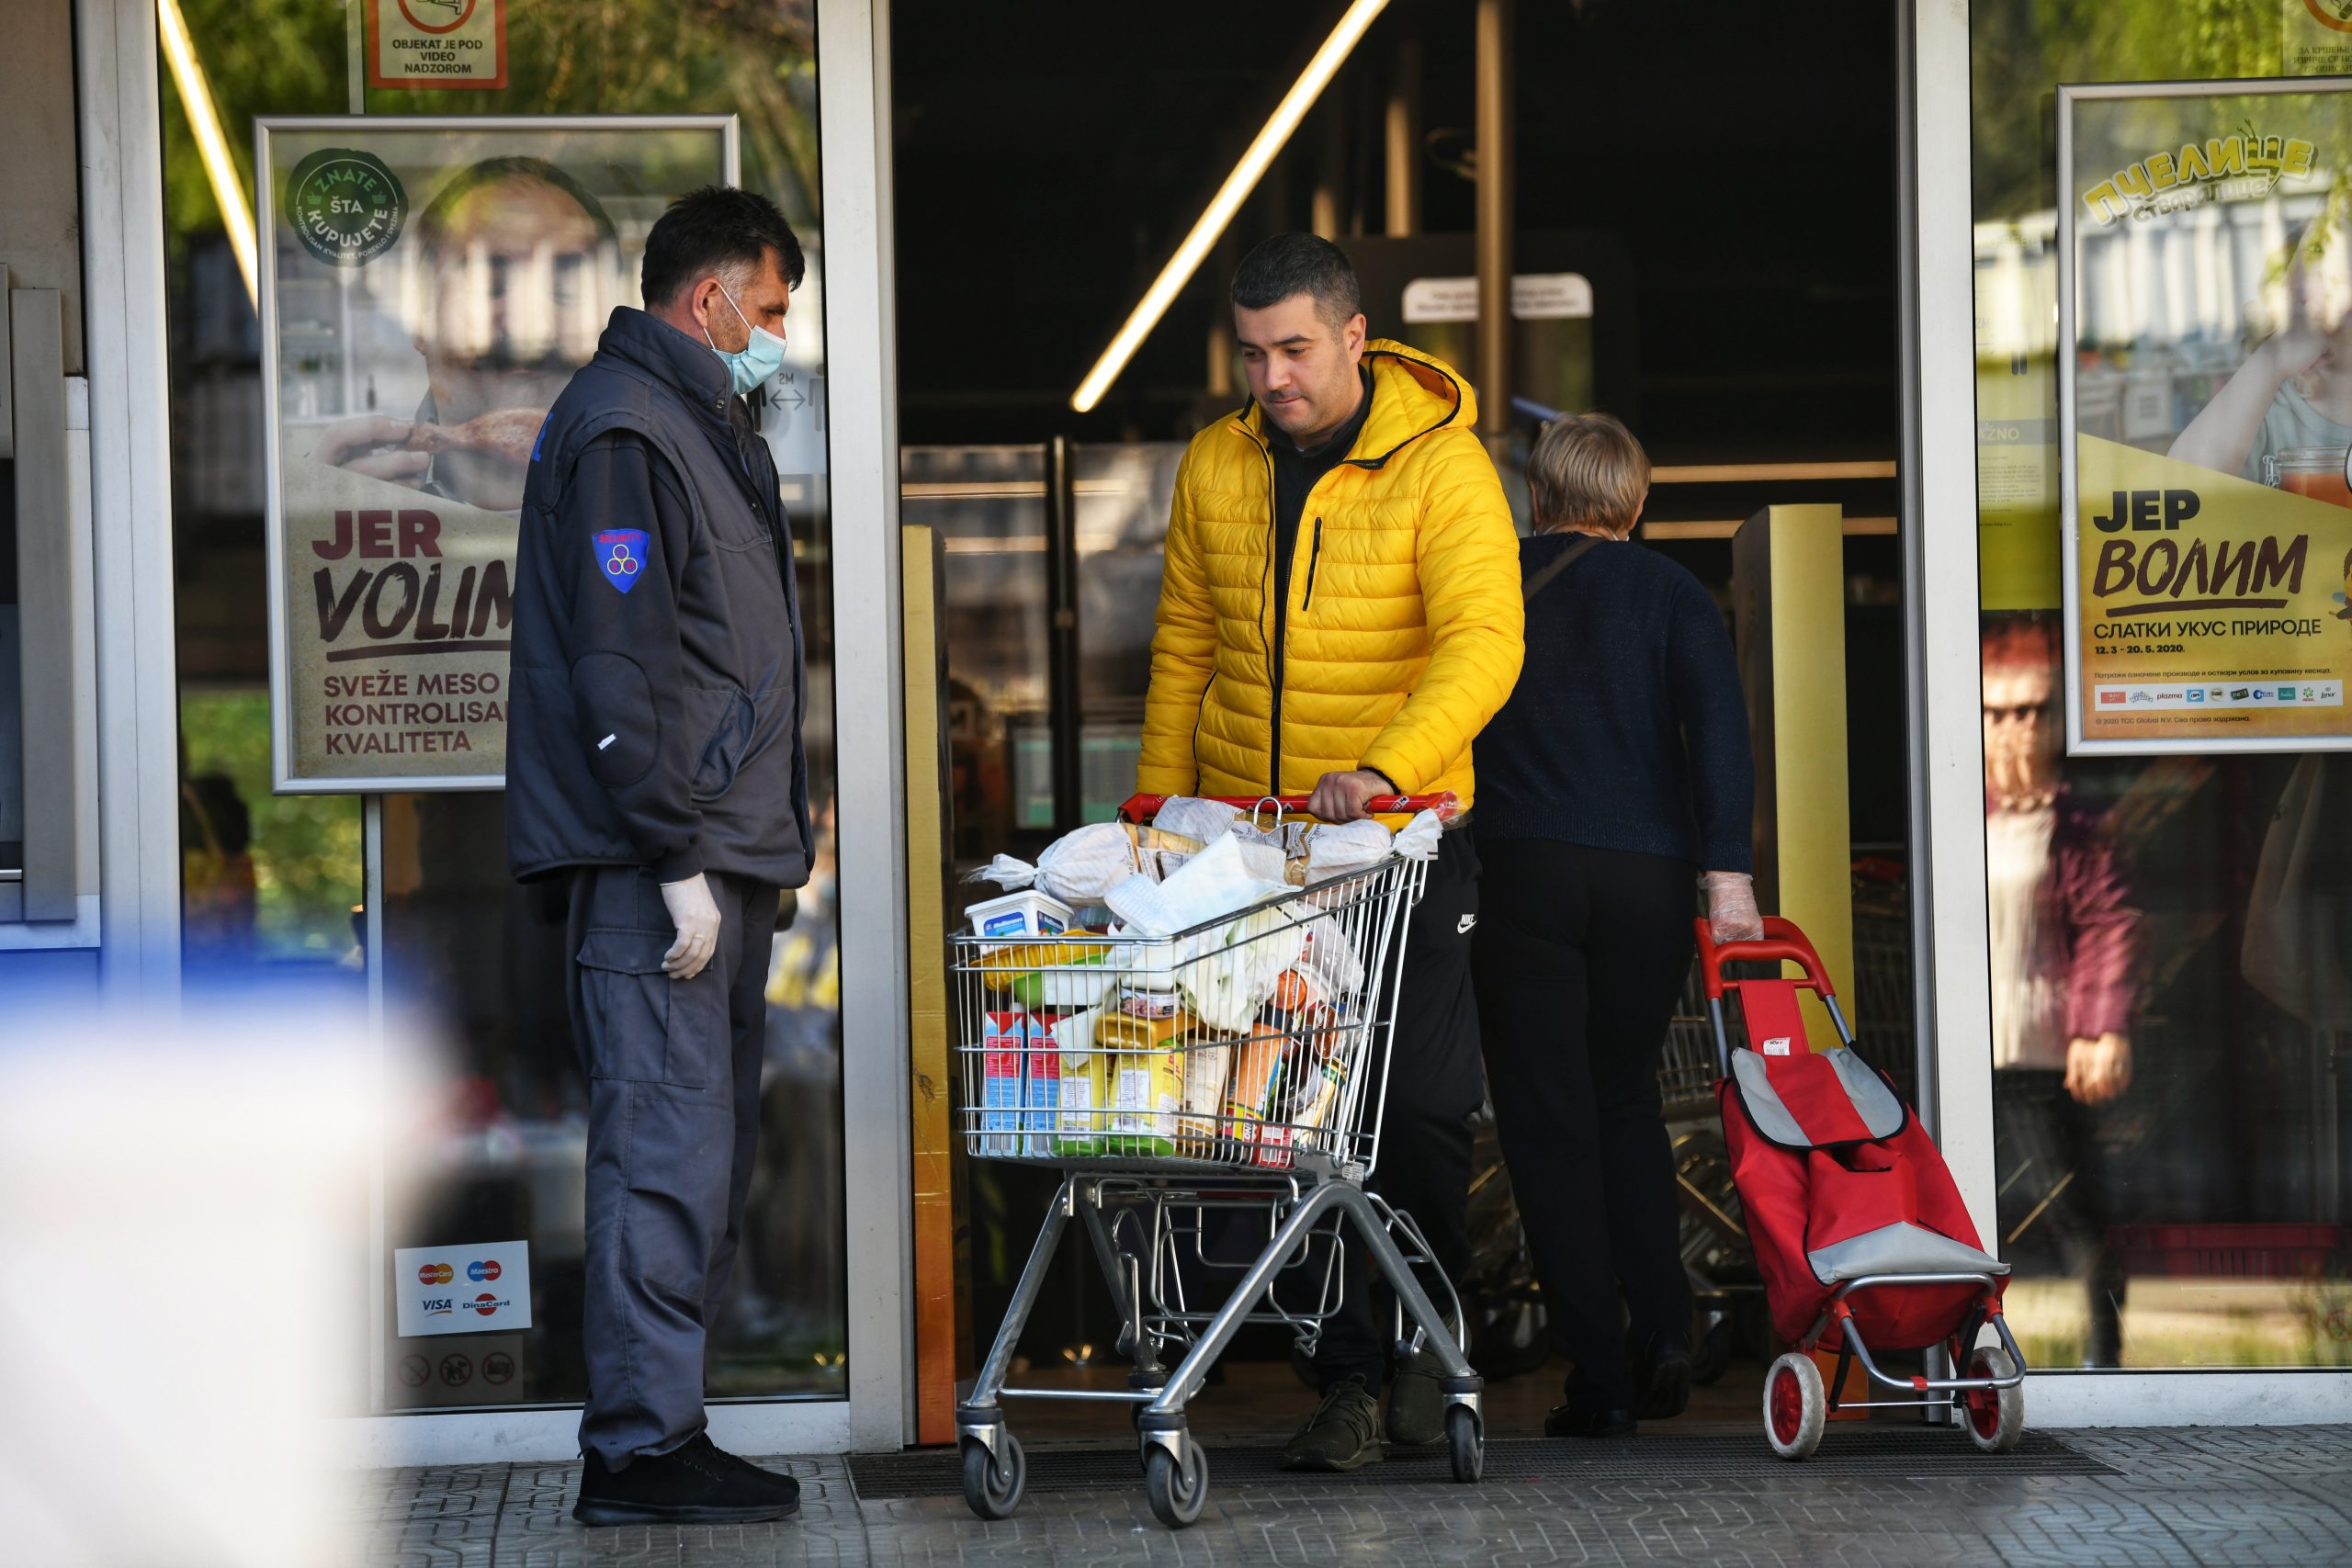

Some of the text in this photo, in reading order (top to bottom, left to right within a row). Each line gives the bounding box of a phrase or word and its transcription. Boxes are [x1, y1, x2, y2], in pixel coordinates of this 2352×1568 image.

[392, 39, 483, 50] OBJEKAT JE POD
[420, 51, 456, 62] VIDEO
[404, 63, 472, 73] NADZOROM
[314, 168, 378, 194] ZNATE
[2082, 135, 2315, 224] ПЧЕЛИЦЕ
[330, 196, 364, 214] ŠTA
[296, 206, 323, 251] KONTROLISAN
[357, 238, 388, 258] POREKLO
[307, 209, 388, 248] KUPUJETE
[778, 372, 794, 385] 2M
[2093, 490, 2200, 533] ЈЕР
[311, 509, 443, 560] JER
[2093, 535, 2309, 598] ВОЛИМ
[2094, 618, 2322, 639] СЛАТКИ УКУС ПРИРОДЕ
[2095, 646, 2109, 655] 12.
[2126, 645, 2143, 654] 20.
[2145, 645, 2155, 654] 5.
[2156, 644, 2186, 654] 2020.
[323, 669, 501, 698] SVEŽE MESO
[2156, 693, 2183, 701] plazma
[325, 701, 509, 727] KONTROLISA
[326, 730, 472, 755] KVALITETA
[1460, 913, 1476, 925] NIKE
[419, 1270, 453, 1279] MasterCard
[469, 1267, 499, 1276] Maestro
[422, 1299, 453, 1311] VISA
[462, 1299, 511, 1310] DinaCard
